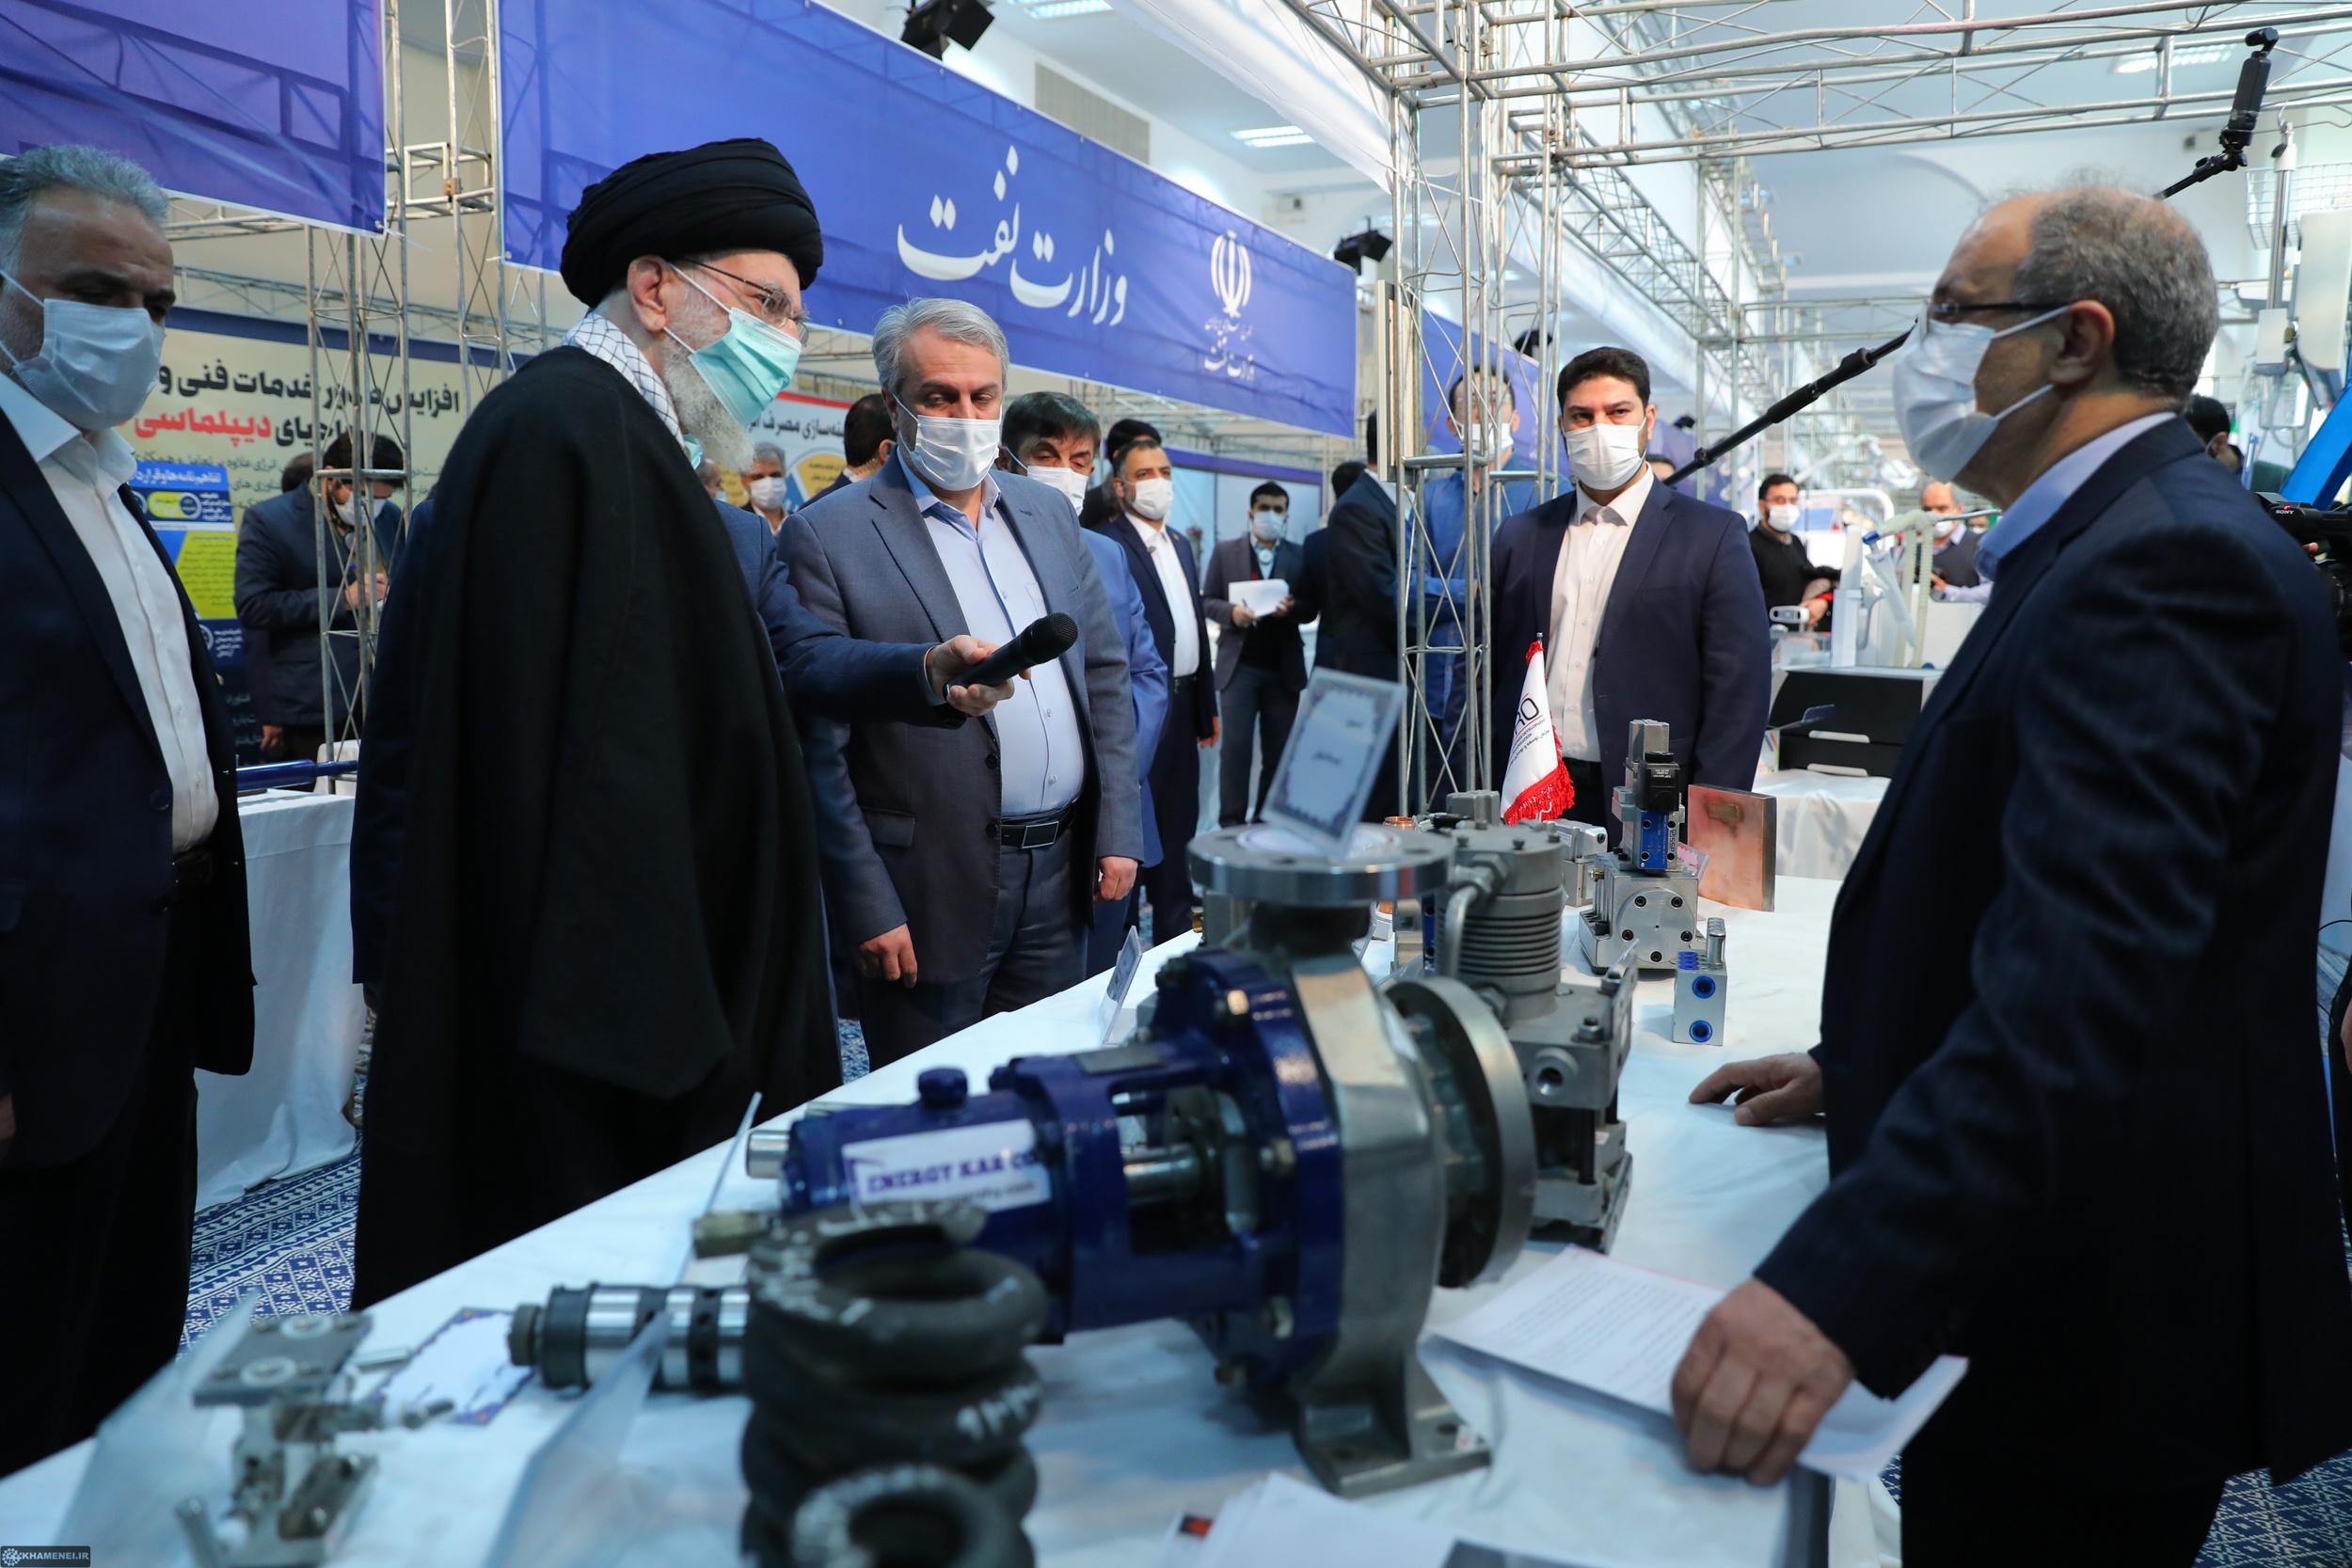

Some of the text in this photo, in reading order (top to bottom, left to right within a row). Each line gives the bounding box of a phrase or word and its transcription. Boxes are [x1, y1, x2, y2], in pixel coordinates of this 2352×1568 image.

[897, 144, 1128, 326] وزارت نفت
[158, 365, 173, 395] و
[178, 358, 230, 397] فنی
[134, 406, 272, 448] دیپلماسی
[866, 1164, 951, 1194] ENERGY
